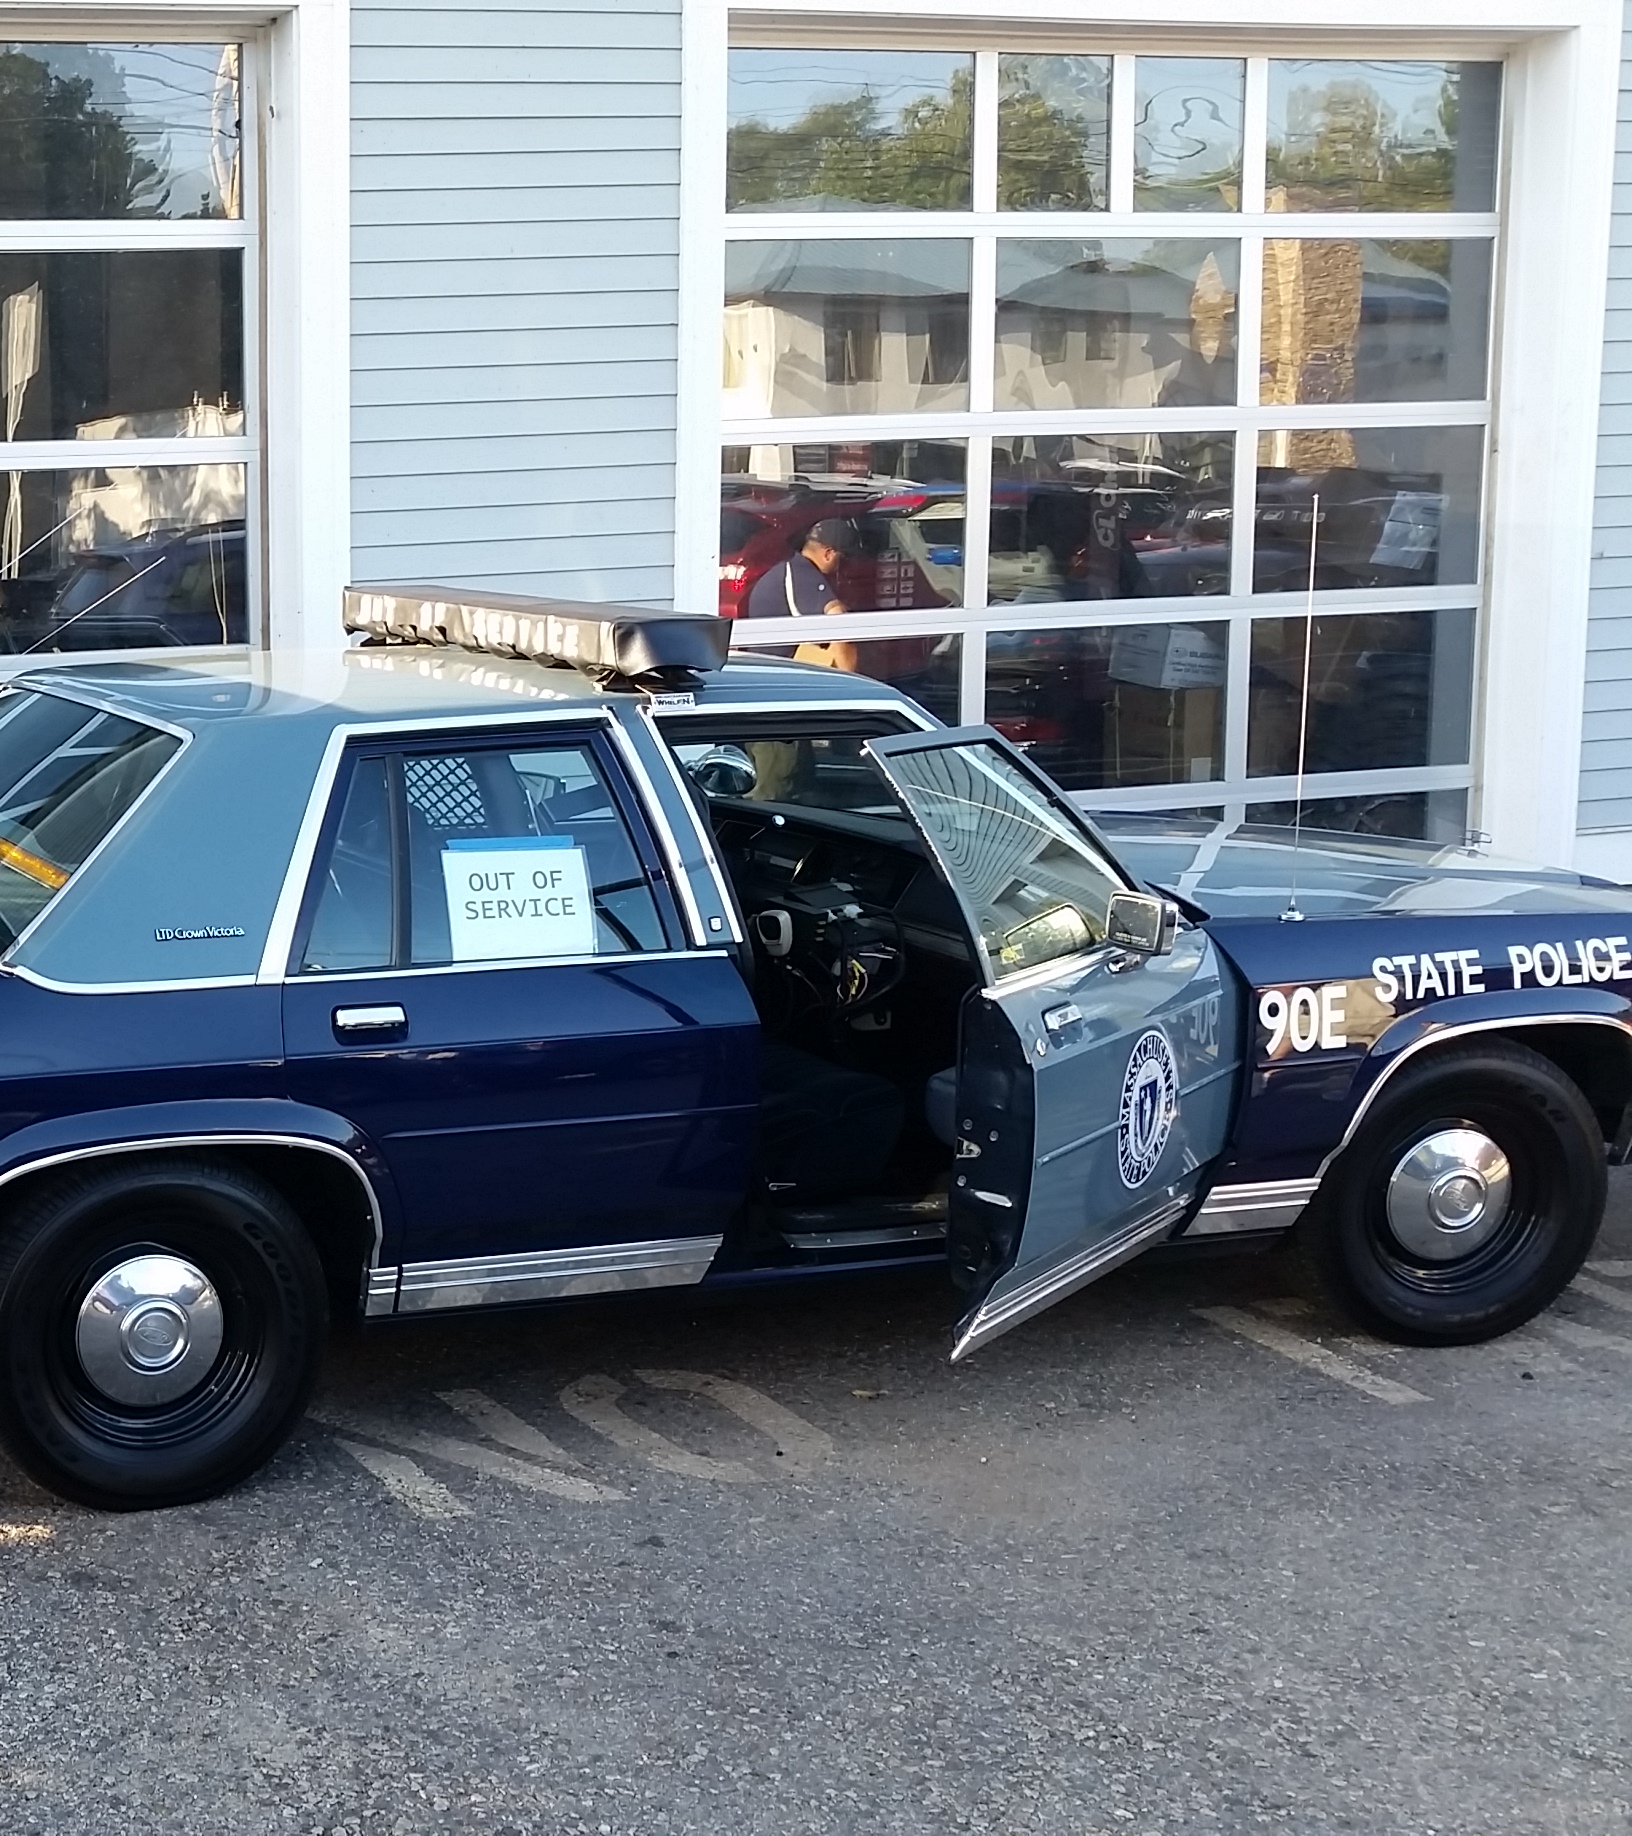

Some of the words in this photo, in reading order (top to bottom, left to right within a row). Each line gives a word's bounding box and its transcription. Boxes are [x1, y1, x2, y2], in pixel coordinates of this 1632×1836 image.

[465, 897, 576, 920] SERVICE
[468, 871, 515, 892] OUT
[532, 870, 562, 889] OF
[155, 928, 174, 941] LTD
[175, 927, 208, 939] Crown
[206, 926, 245, 937] Victoria
[1372, 950, 1485, 1003] STATE
[1506, 936, 1632, 987] POLICE
[1259, 986, 1347, 1056] 90E
[1122, 1035, 1175, 1125] MASSACHUSETTS
[1120, 1136, 1138, 1183] STATE
[1138, 1107, 1172, 1181] POLICE
[304, 1368, 835, 1520] NO
